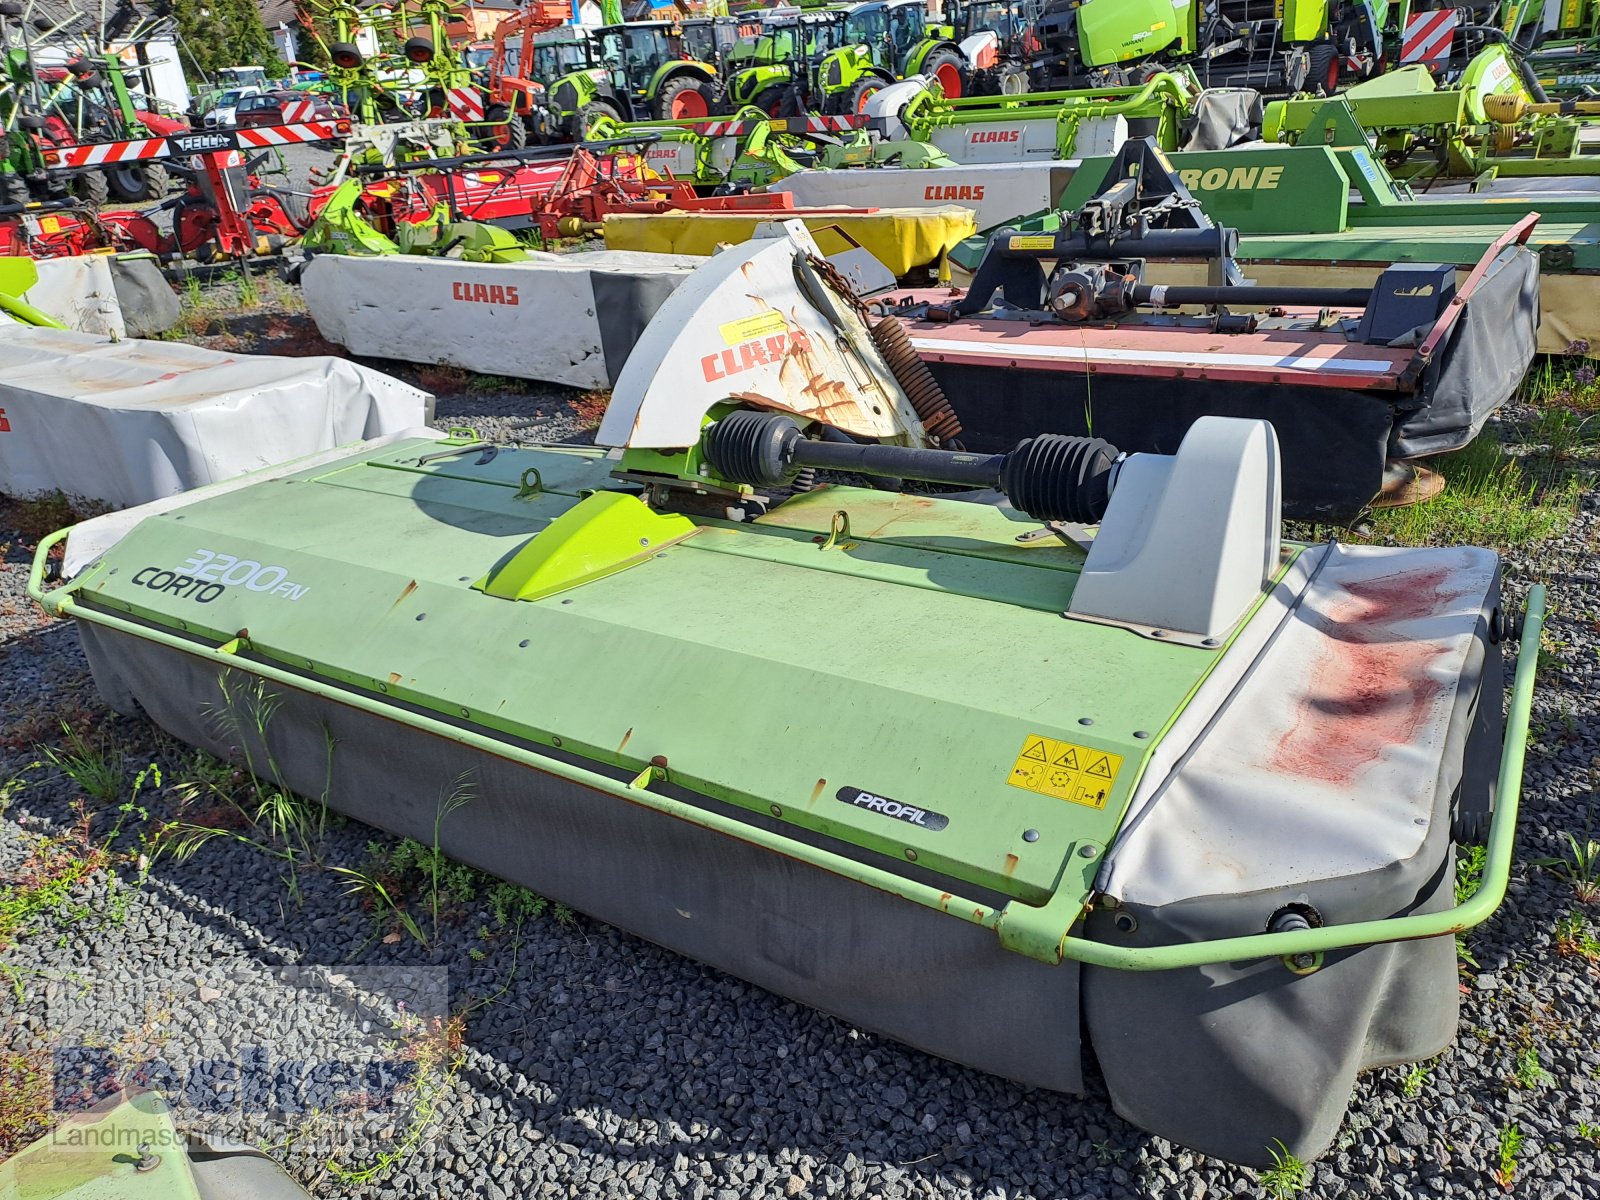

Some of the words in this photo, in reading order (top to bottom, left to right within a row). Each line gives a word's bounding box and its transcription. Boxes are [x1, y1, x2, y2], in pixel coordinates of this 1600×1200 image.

[182, 134, 228, 151] FELLA
[970, 130, 1019, 143] CLAAS
[924, 185, 985, 201] CLAAS
[453, 282, 519, 305] CLAAS
[131, 566, 226, 603] CORTO
[853, 792, 927, 826] PROFIL
